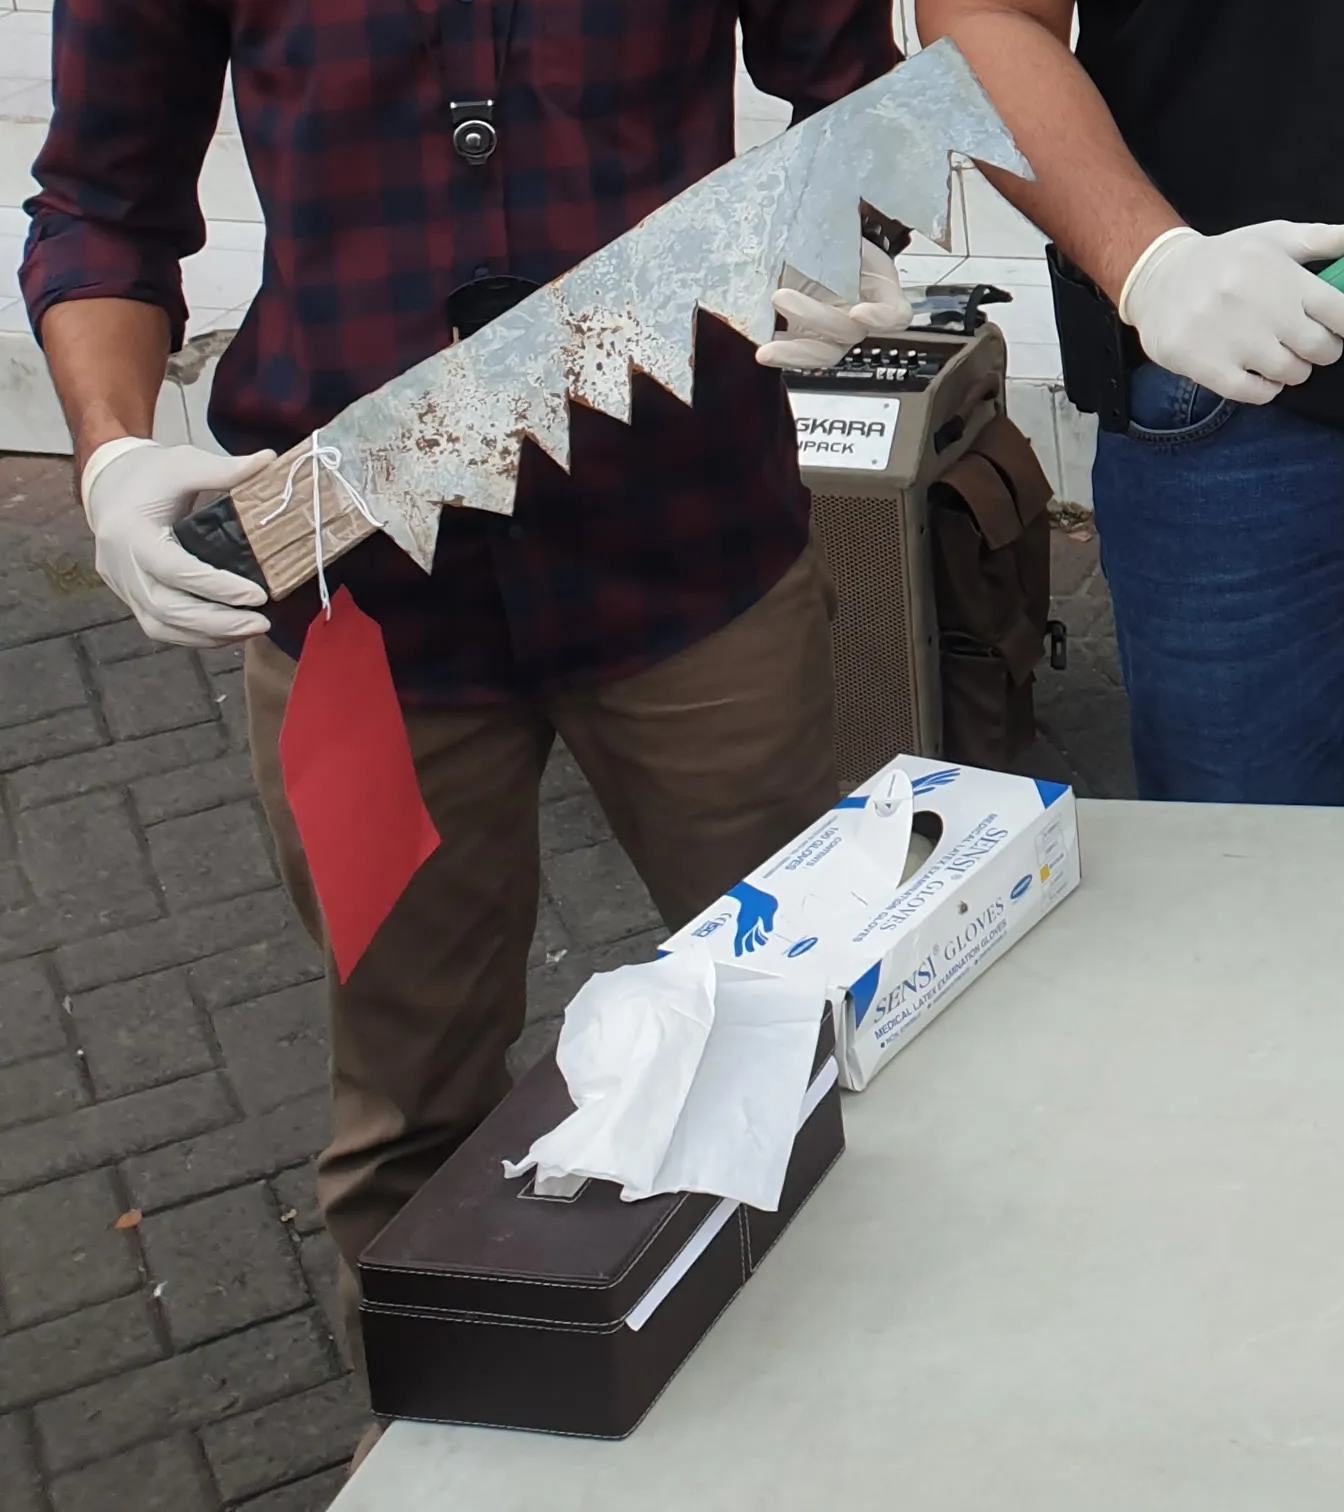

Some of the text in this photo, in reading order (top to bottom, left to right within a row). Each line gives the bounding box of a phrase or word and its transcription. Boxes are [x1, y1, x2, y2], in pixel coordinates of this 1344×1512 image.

[880, 880, 944, 931] GLOVES
[943, 896, 1005, 962] GLOVES
[874, 1008, 913, 1040] MEDICAL
[912, 987, 937, 1016] LATEX
[936, 945, 981, 993] EXAMINATION
[979, 918, 1008, 955] GLOVES
